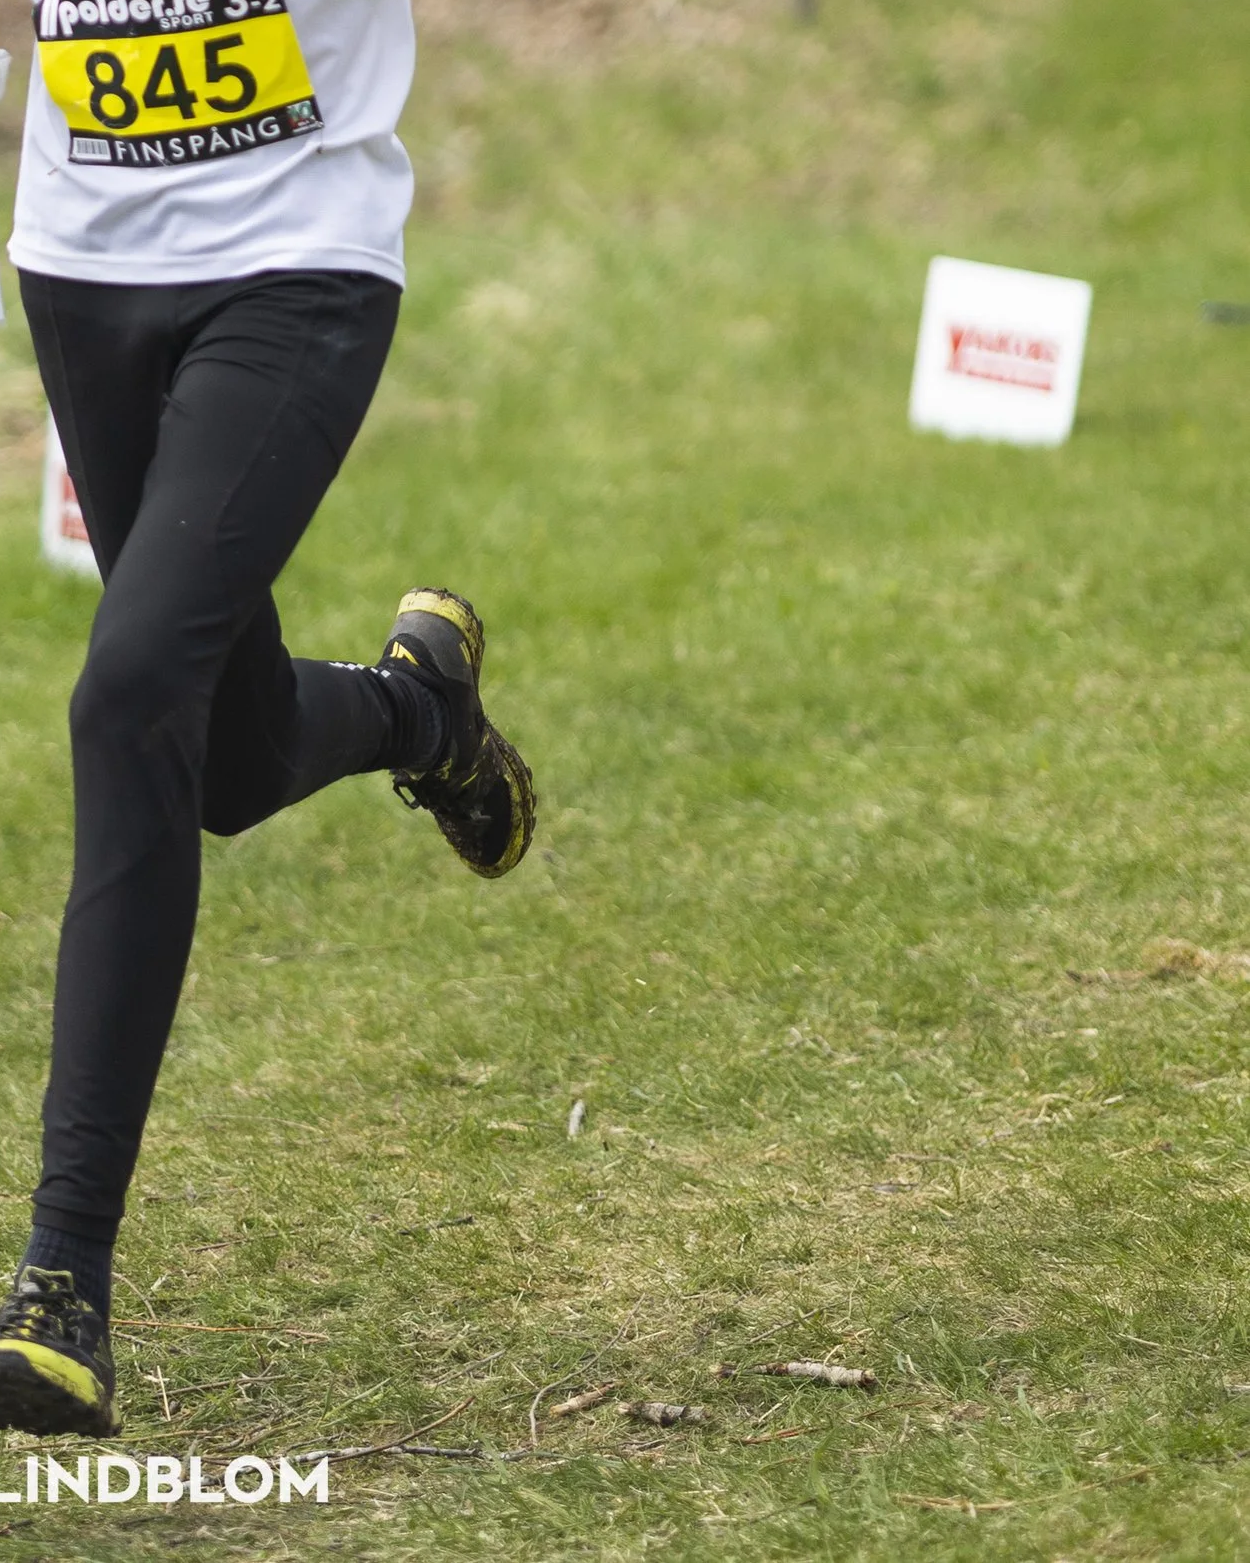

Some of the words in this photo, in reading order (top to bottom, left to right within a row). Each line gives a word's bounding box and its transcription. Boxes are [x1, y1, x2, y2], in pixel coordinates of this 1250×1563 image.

[159, 11, 214, 30] SPORT
[85, 32, 257, 130] 845
[114, 115, 281, 163] FINSPÅNG
